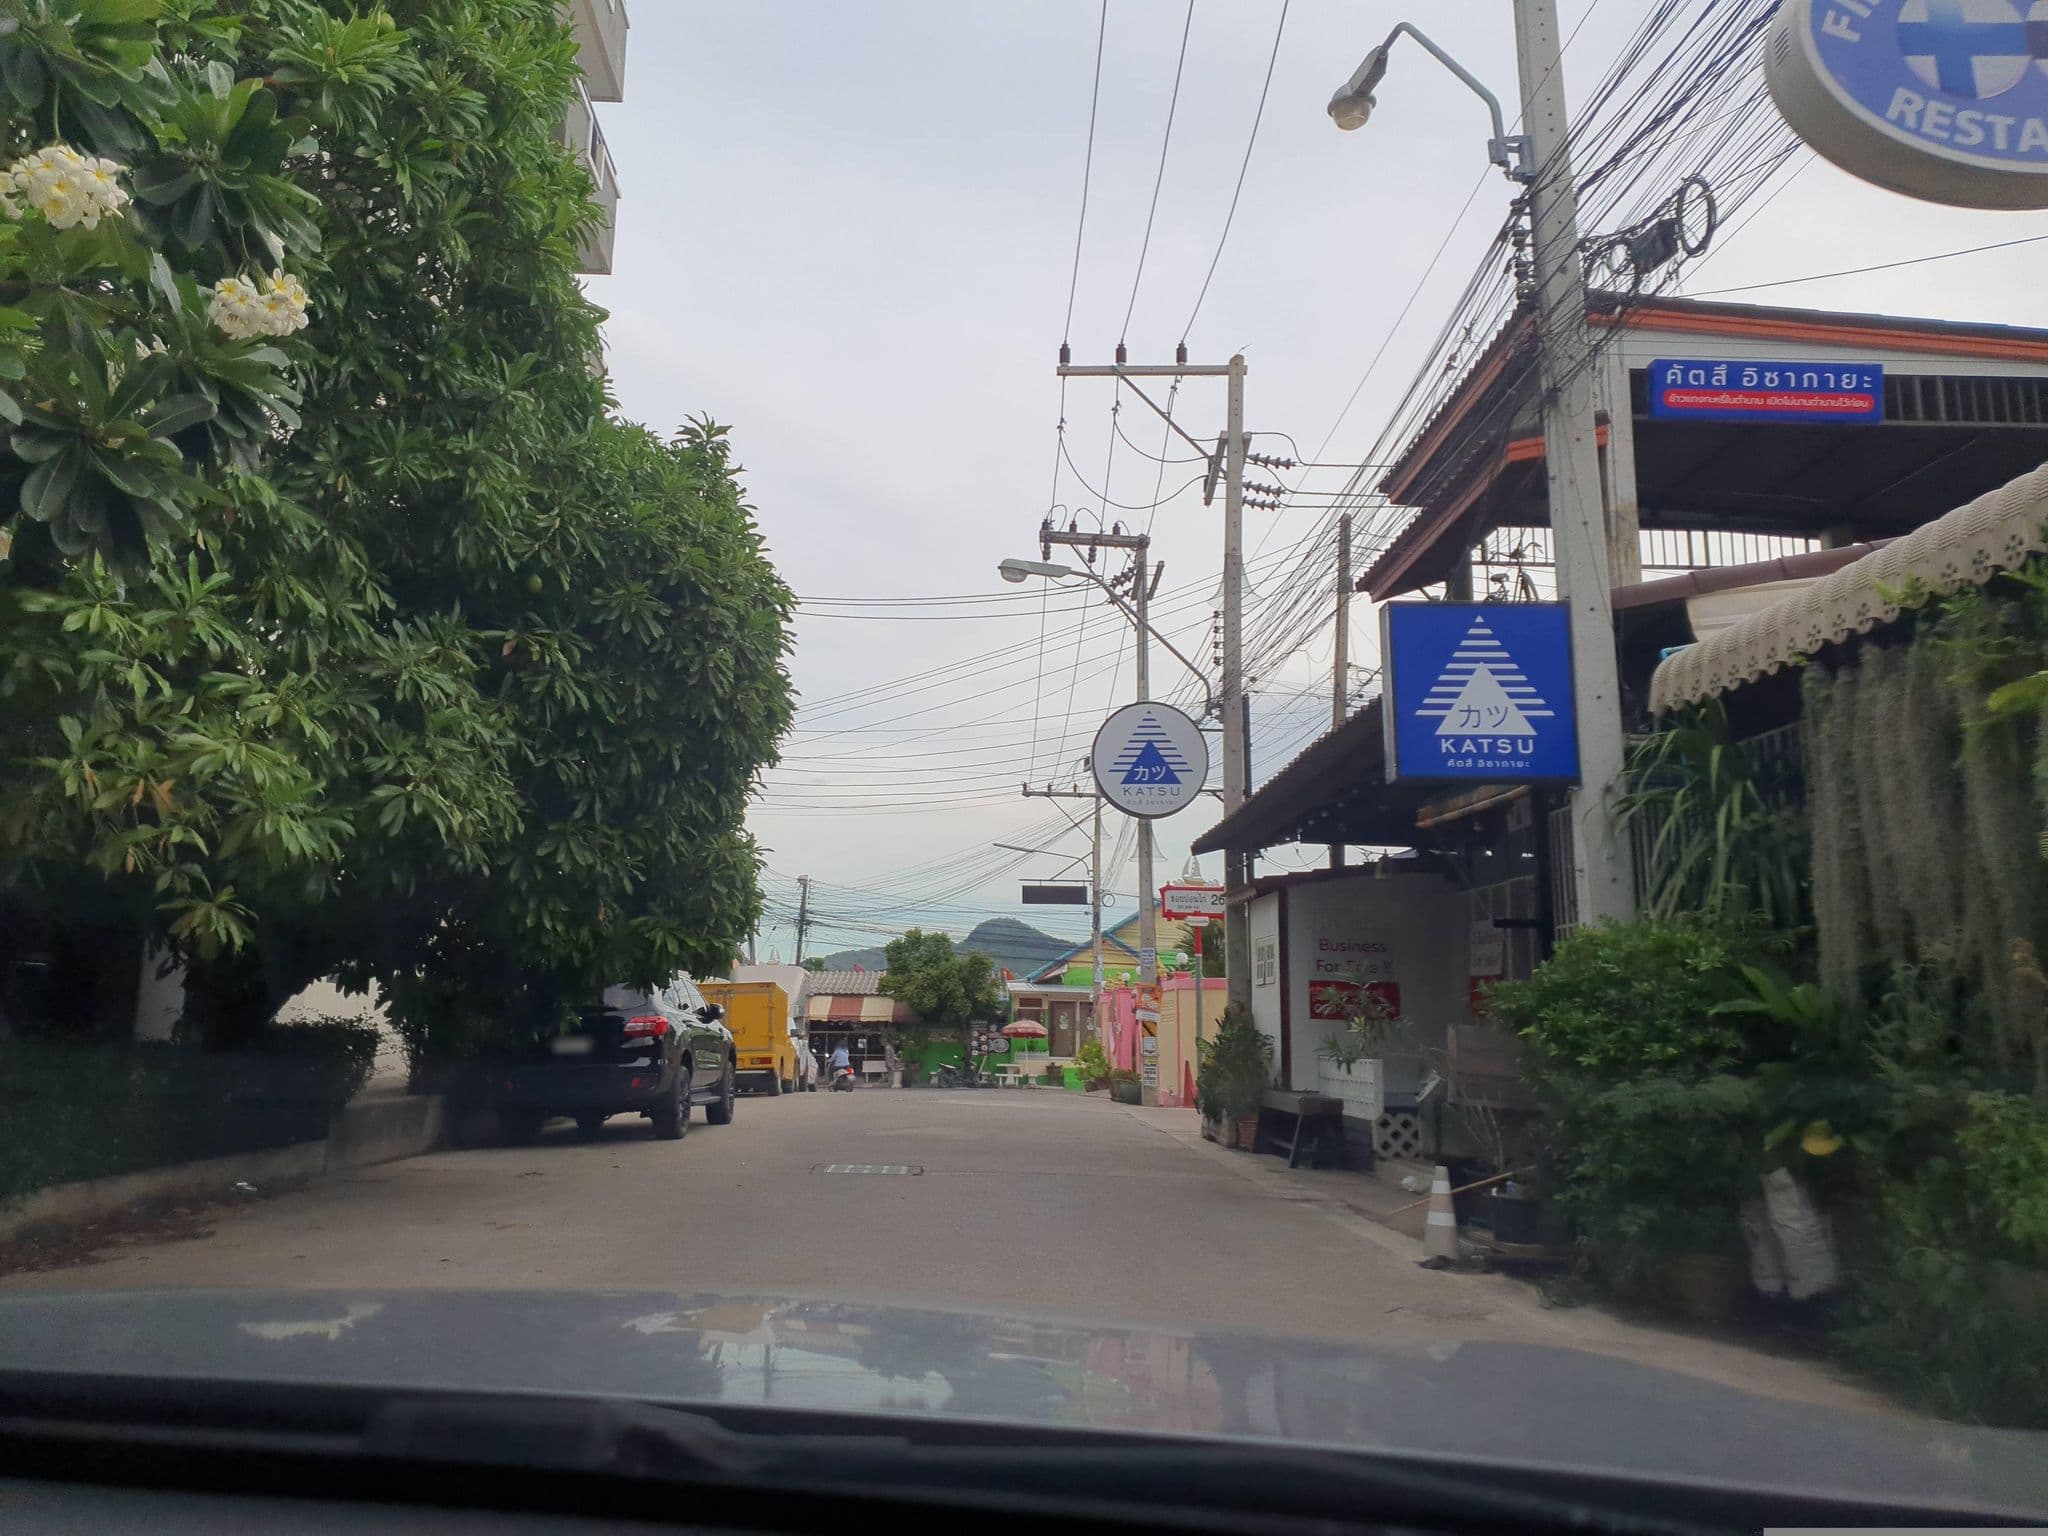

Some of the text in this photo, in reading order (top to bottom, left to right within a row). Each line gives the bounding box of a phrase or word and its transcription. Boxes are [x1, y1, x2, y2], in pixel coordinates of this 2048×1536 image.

[1666, 364, 1873, 389] คัตสึ อิซากายะ
[1459, 705, 1509, 728] カツ
[1441, 738, 1535, 754] KATSU
[1134, 766, 1166, 781] カツ
[1123, 787, 1181, 796] KATSU
[1319, 938, 1387, 953] Business
[1317, 960, 1341, 972] For
